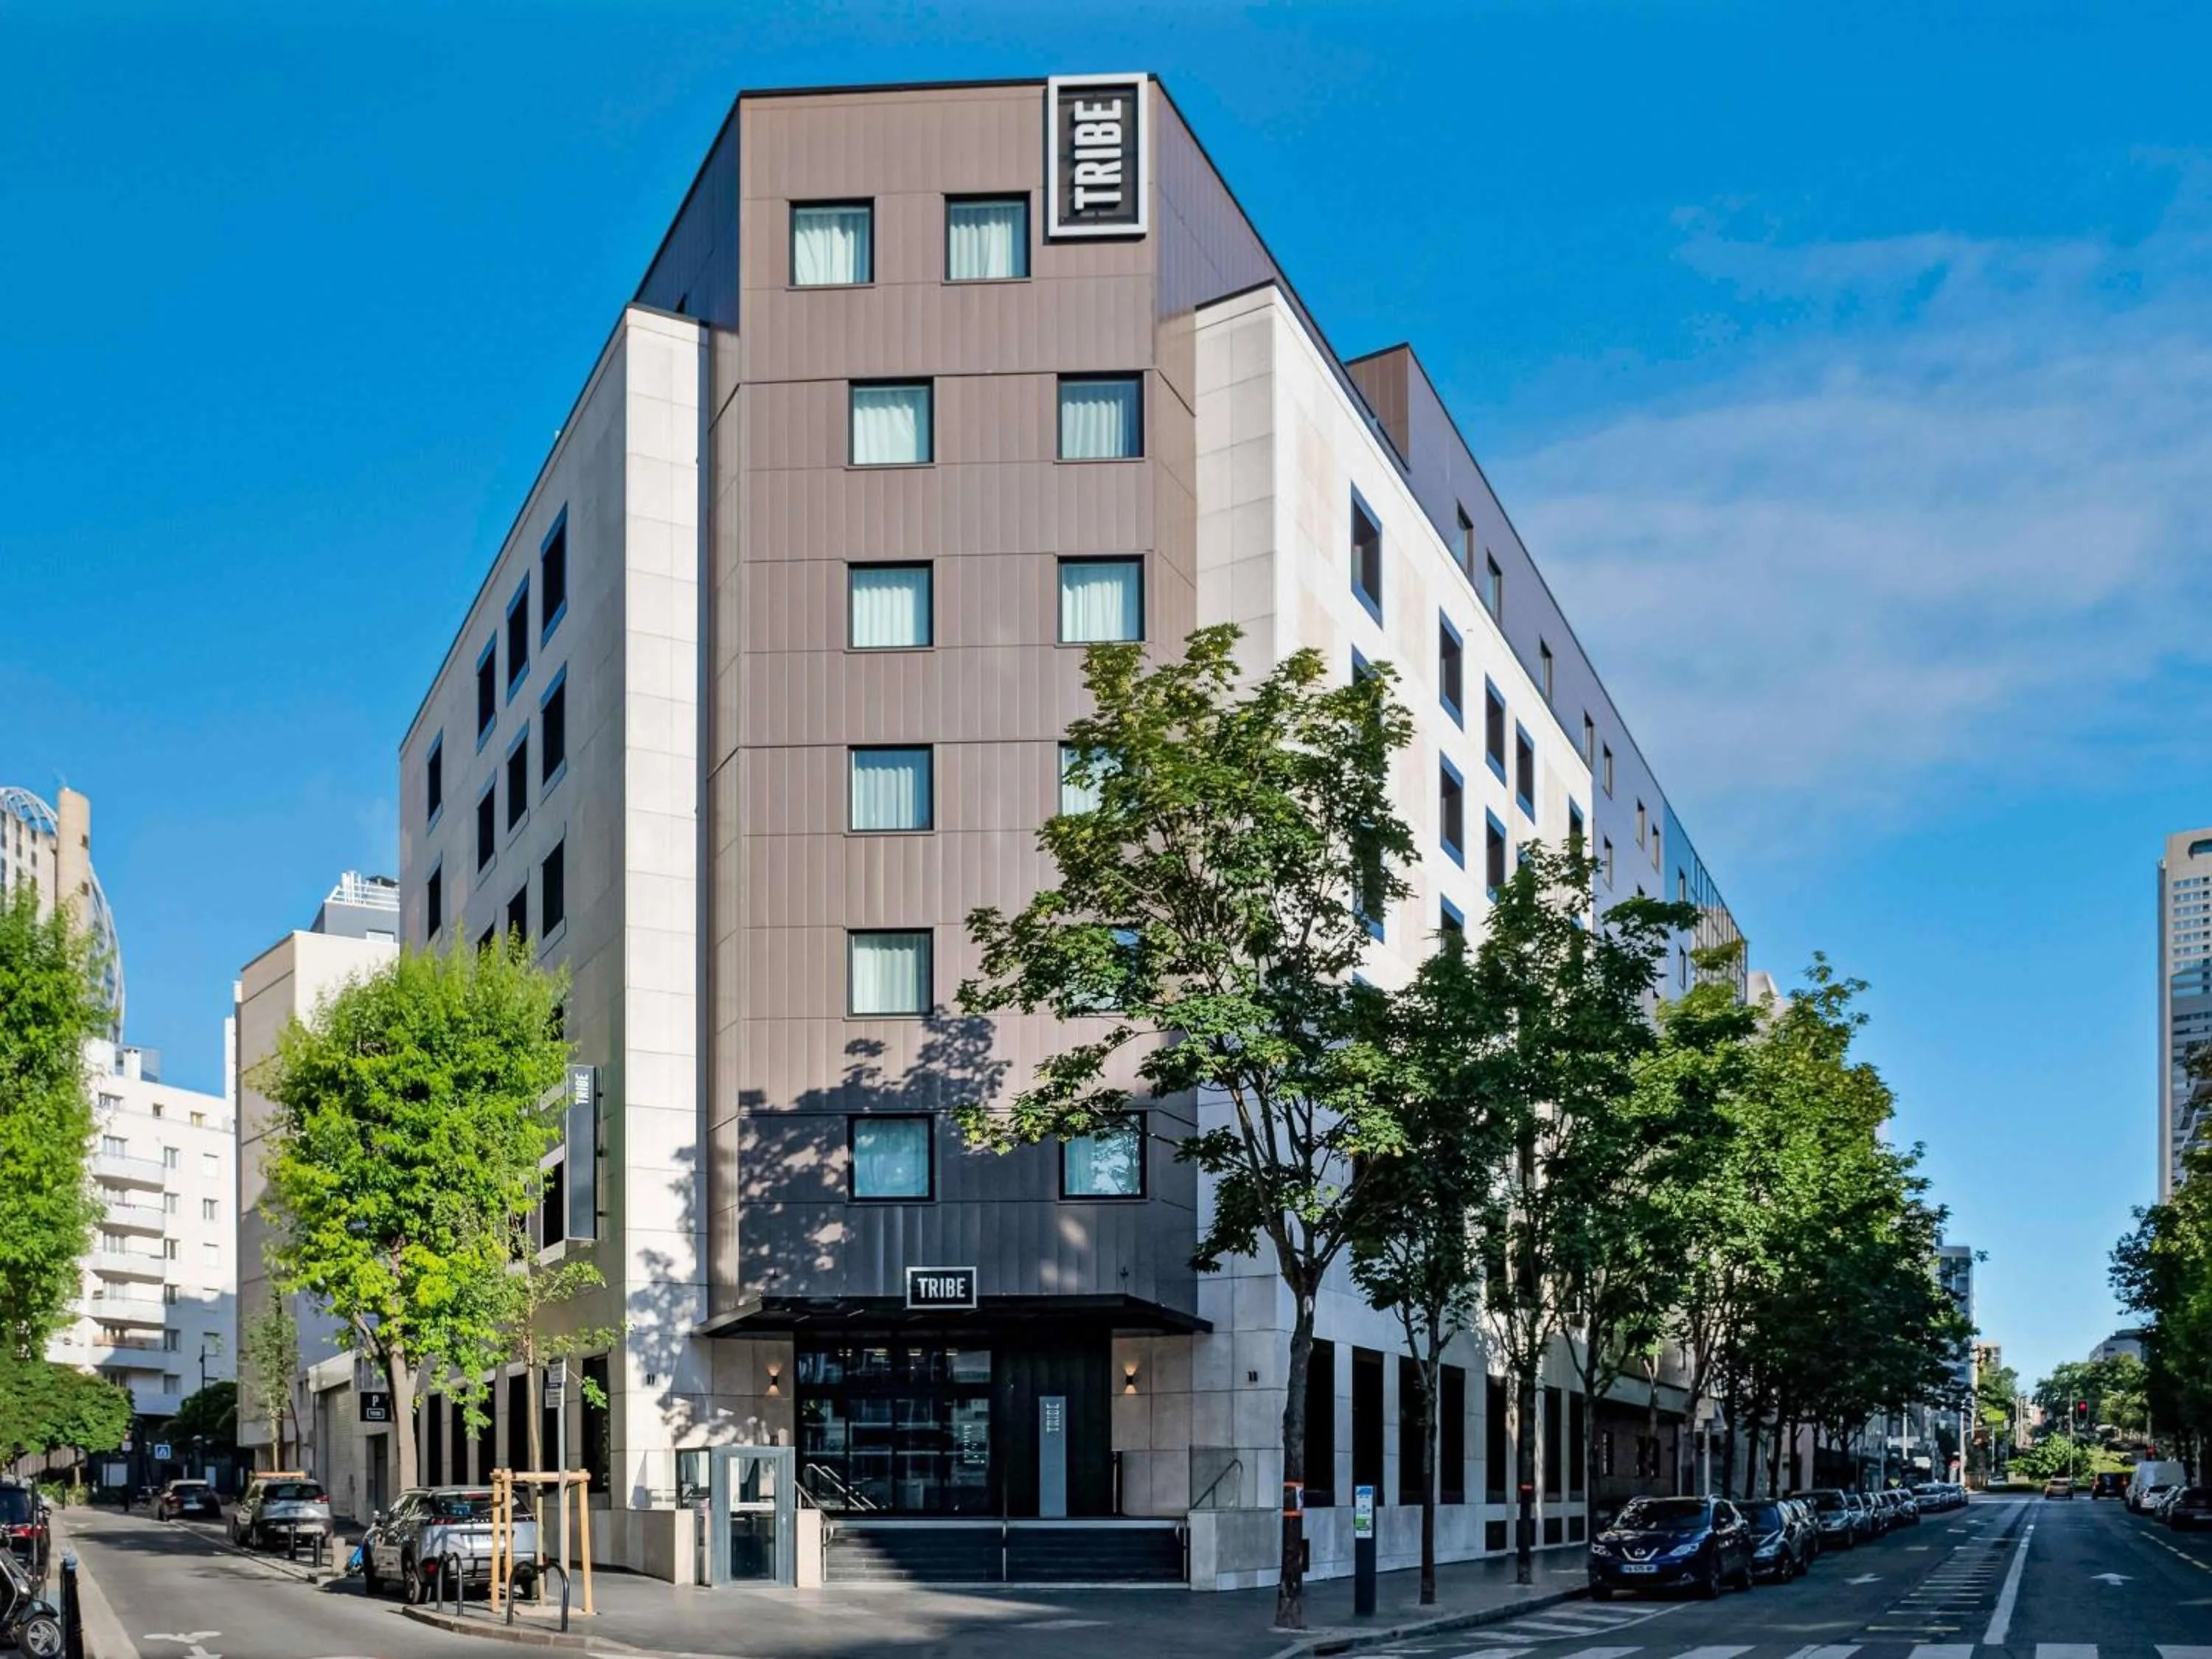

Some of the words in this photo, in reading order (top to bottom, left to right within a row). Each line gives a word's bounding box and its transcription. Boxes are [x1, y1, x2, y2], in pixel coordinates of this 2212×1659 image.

[1074, 99, 1122, 210] TRIBE
[917, 1277, 966, 1298] TRIBE
[372, 1394, 379, 1407] P
